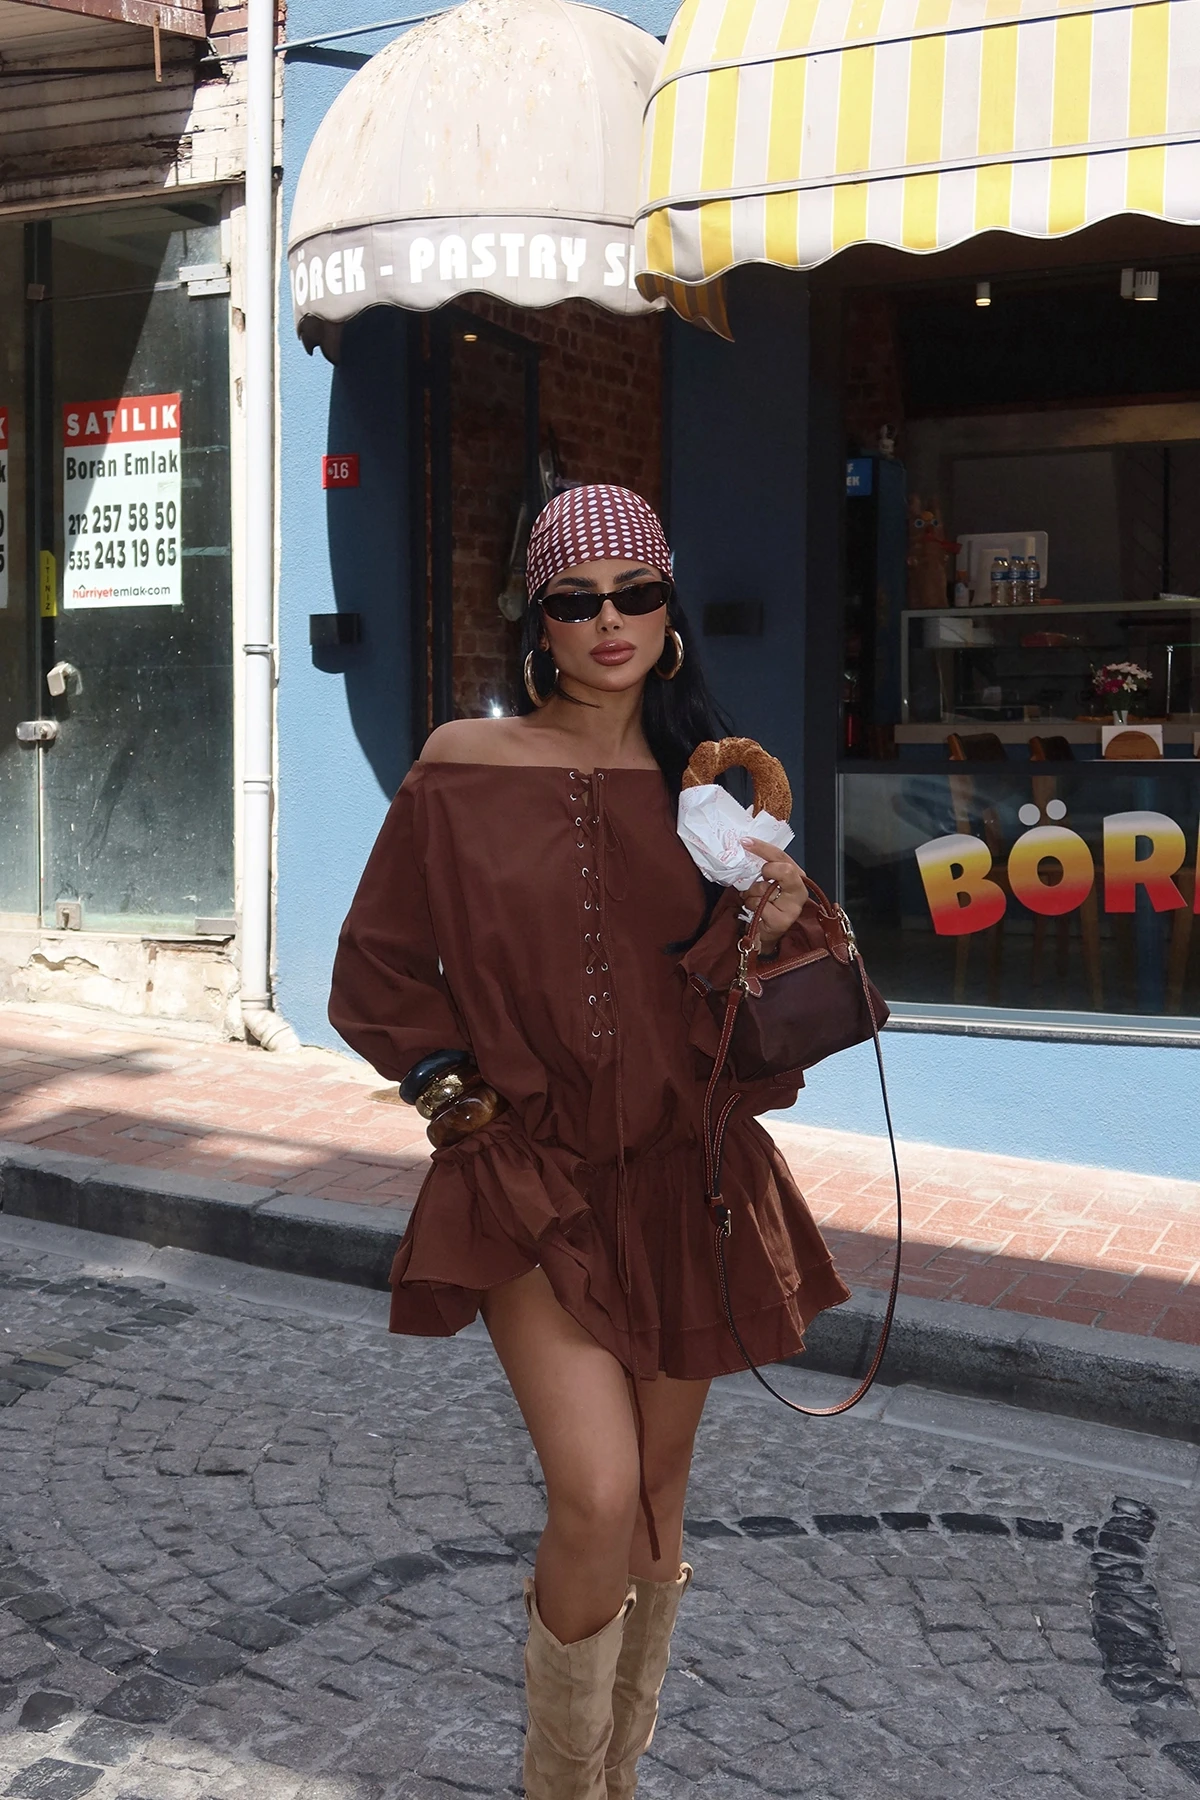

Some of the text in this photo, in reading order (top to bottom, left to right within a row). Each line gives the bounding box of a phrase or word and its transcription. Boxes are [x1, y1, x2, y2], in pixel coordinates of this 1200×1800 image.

[290, 247, 366, 310] ÖREK
[408, 233, 587, 284] PASTRY
[66, 404, 177, 437] SATILIK
[66, 449, 178, 481] Boran Emlak
[332, 461, 349, 479] 16
[68, 500, 176, 535] 212 257 58 50
[69, 537, 176, 571] 535 243 19 65
[915, 799, 1200, 936] BÖR
